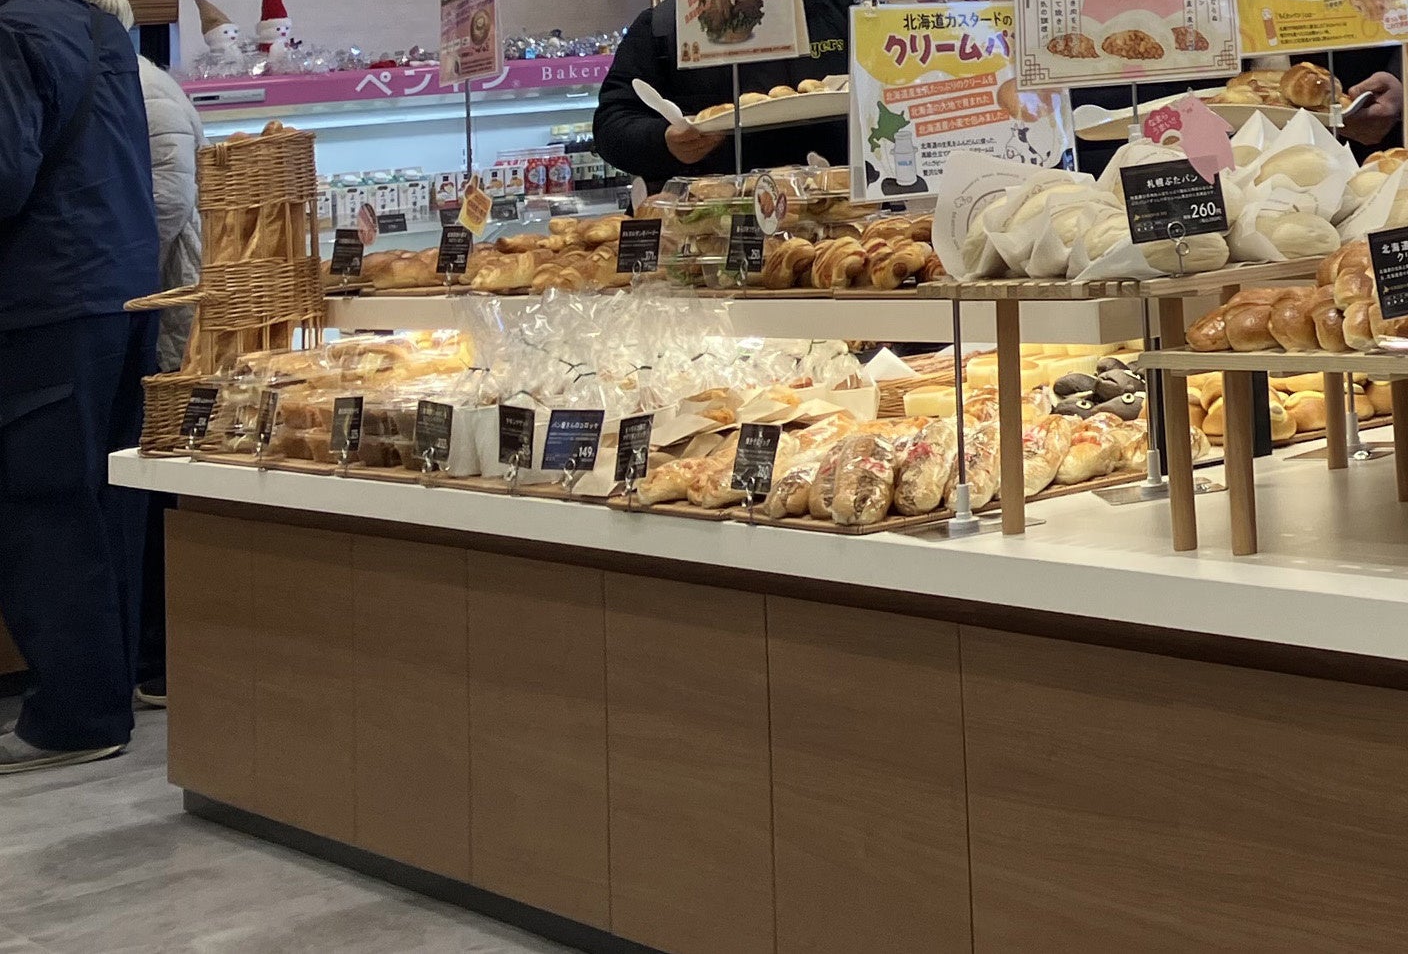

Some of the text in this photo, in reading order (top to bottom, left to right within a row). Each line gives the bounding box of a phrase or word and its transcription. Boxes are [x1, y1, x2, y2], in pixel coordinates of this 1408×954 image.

[903, 11, 1013, 31] 北海道カスタードの
[884, 30, 1015, 66] クリームパ
[355, 67, 510, 95] ペンン
[1147, 173, 1198, 188] 札幌ぶたパン
